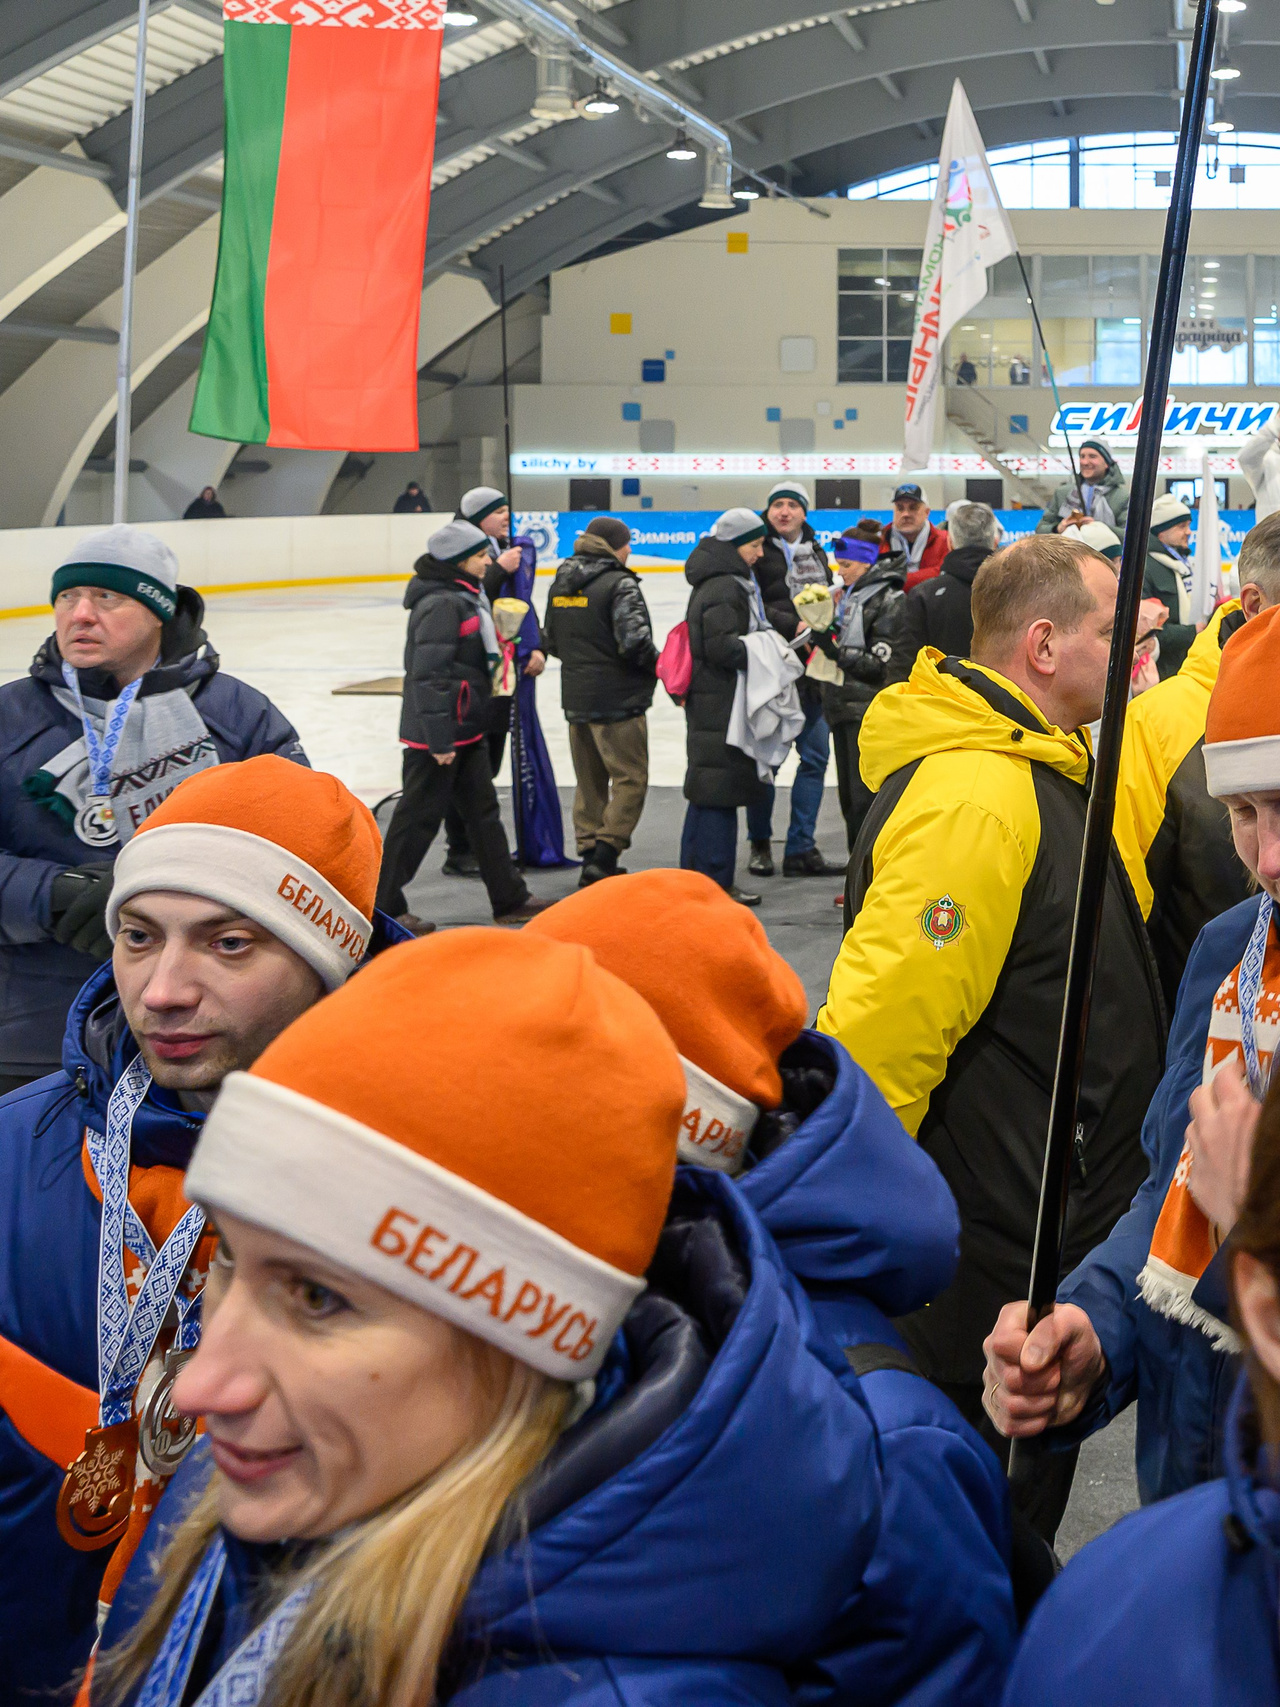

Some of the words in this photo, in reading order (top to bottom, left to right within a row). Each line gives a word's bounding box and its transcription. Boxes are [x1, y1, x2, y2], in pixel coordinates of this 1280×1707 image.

[521, 458, 597, 469] silichy.by
[630, 528, 696, 545] Зимняя
[370, 1206, 597, 1362] БЕЛАРУСЬ
